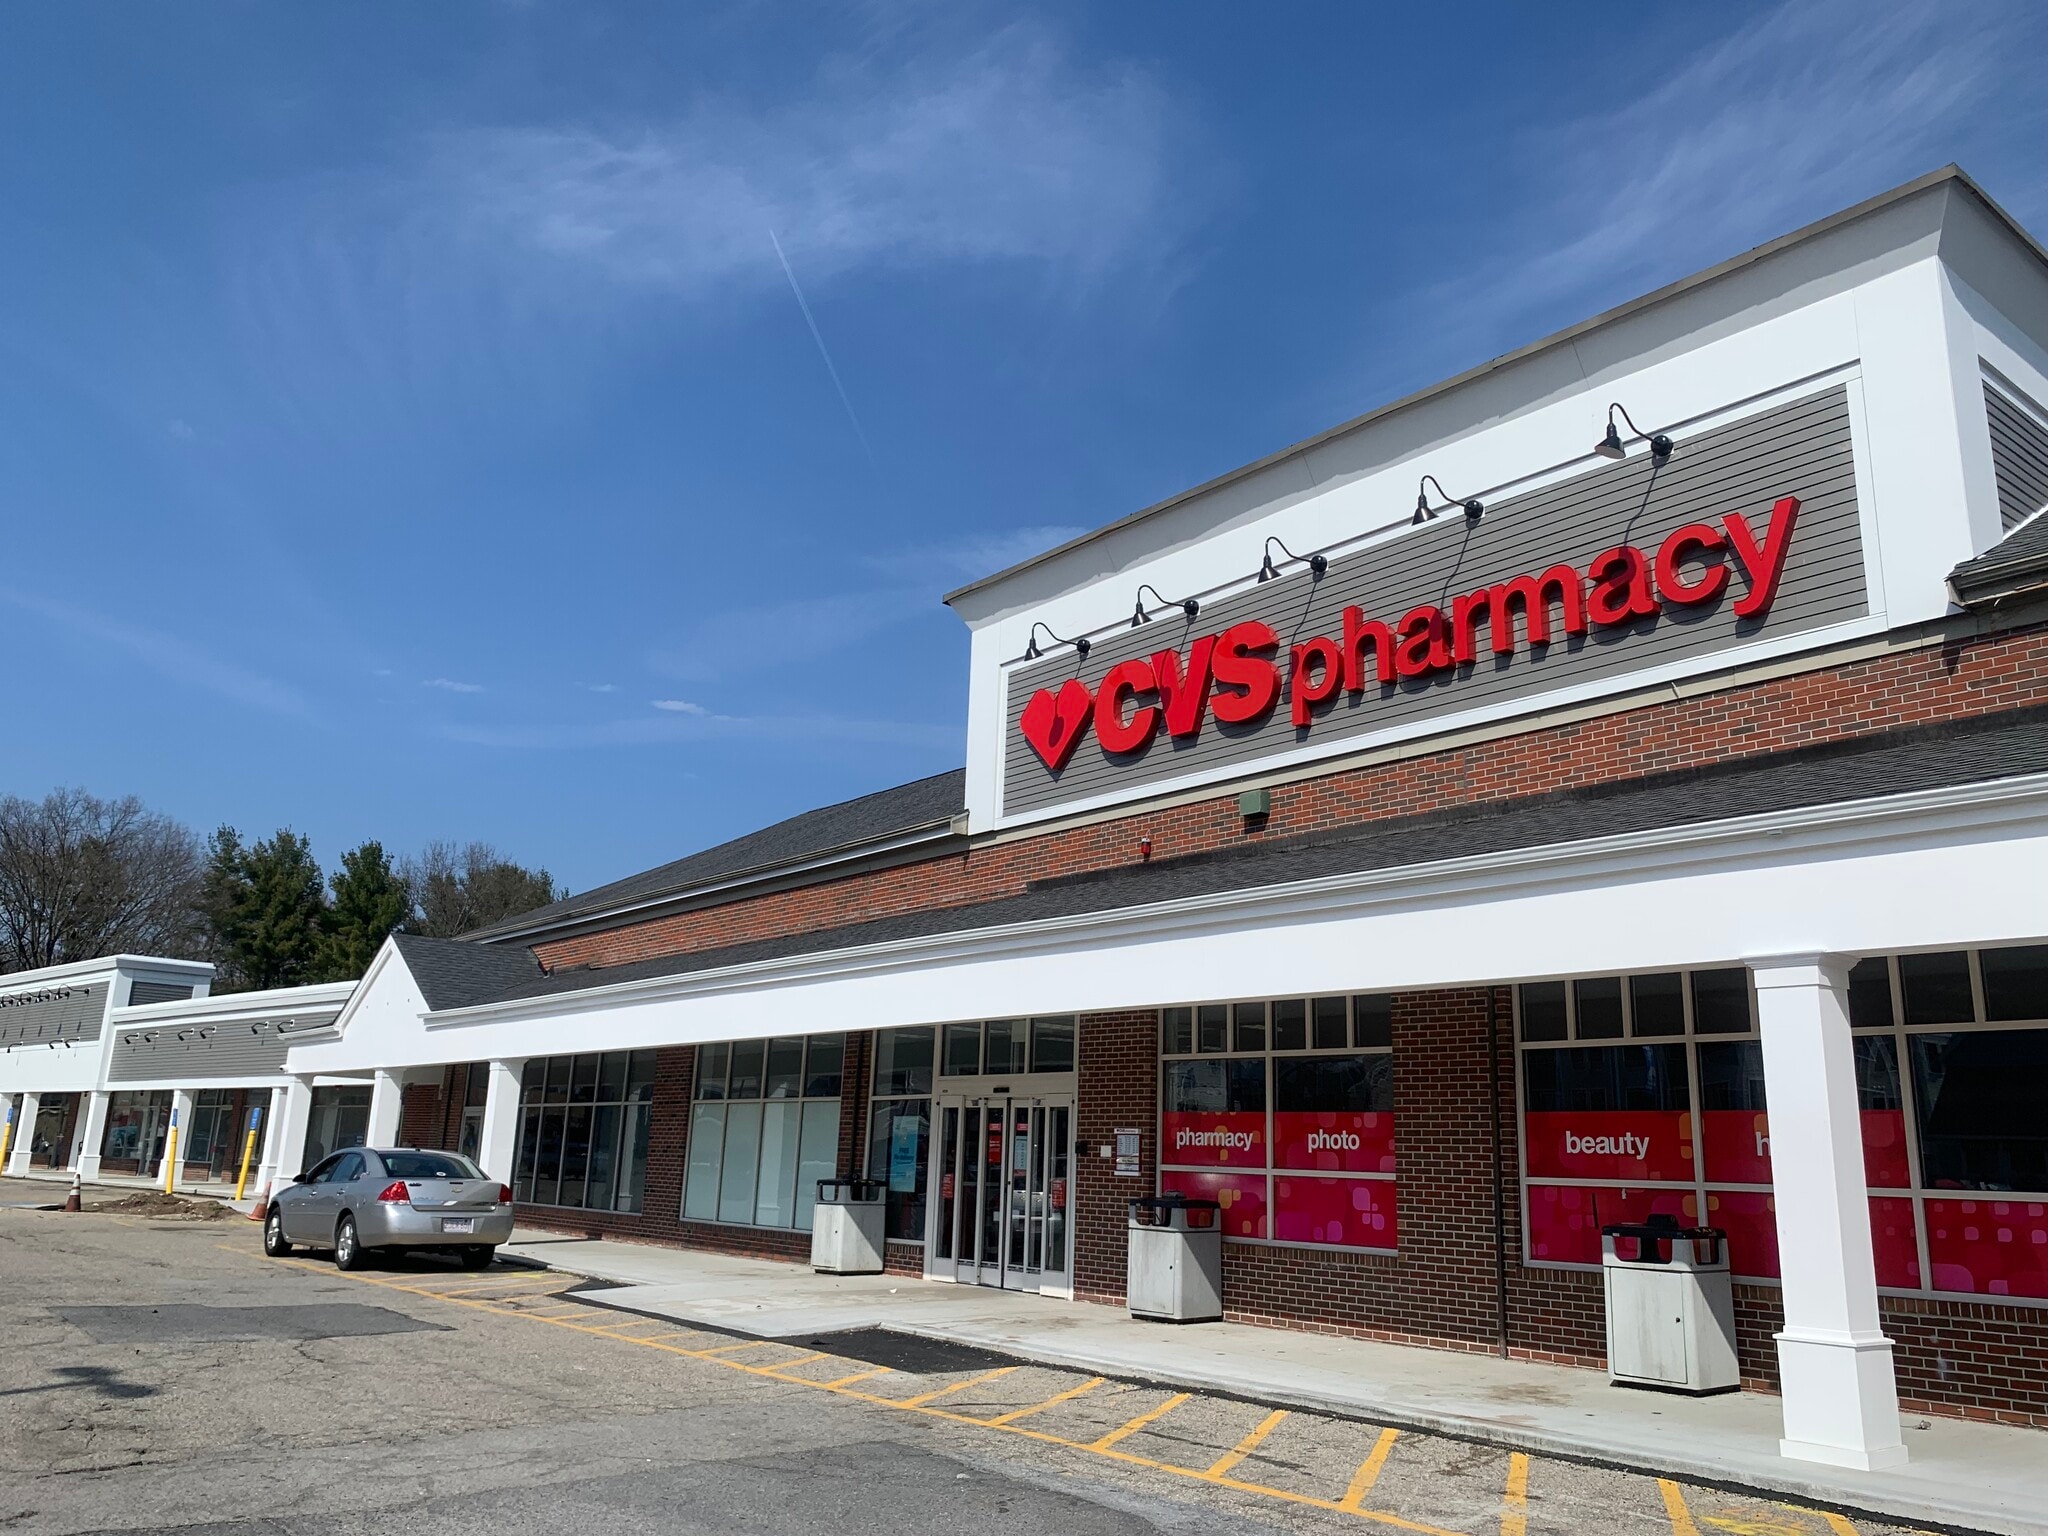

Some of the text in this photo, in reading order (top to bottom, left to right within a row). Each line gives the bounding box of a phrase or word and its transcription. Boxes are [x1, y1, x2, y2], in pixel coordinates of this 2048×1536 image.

[1094, 496, 1802, 754] CVS pharmacy
[1176, 1127, 1253, 1151] pharmacy
[1308, 1129, 1360, 1153] photo
[1565, 1131, 1649, 1160] beauty
